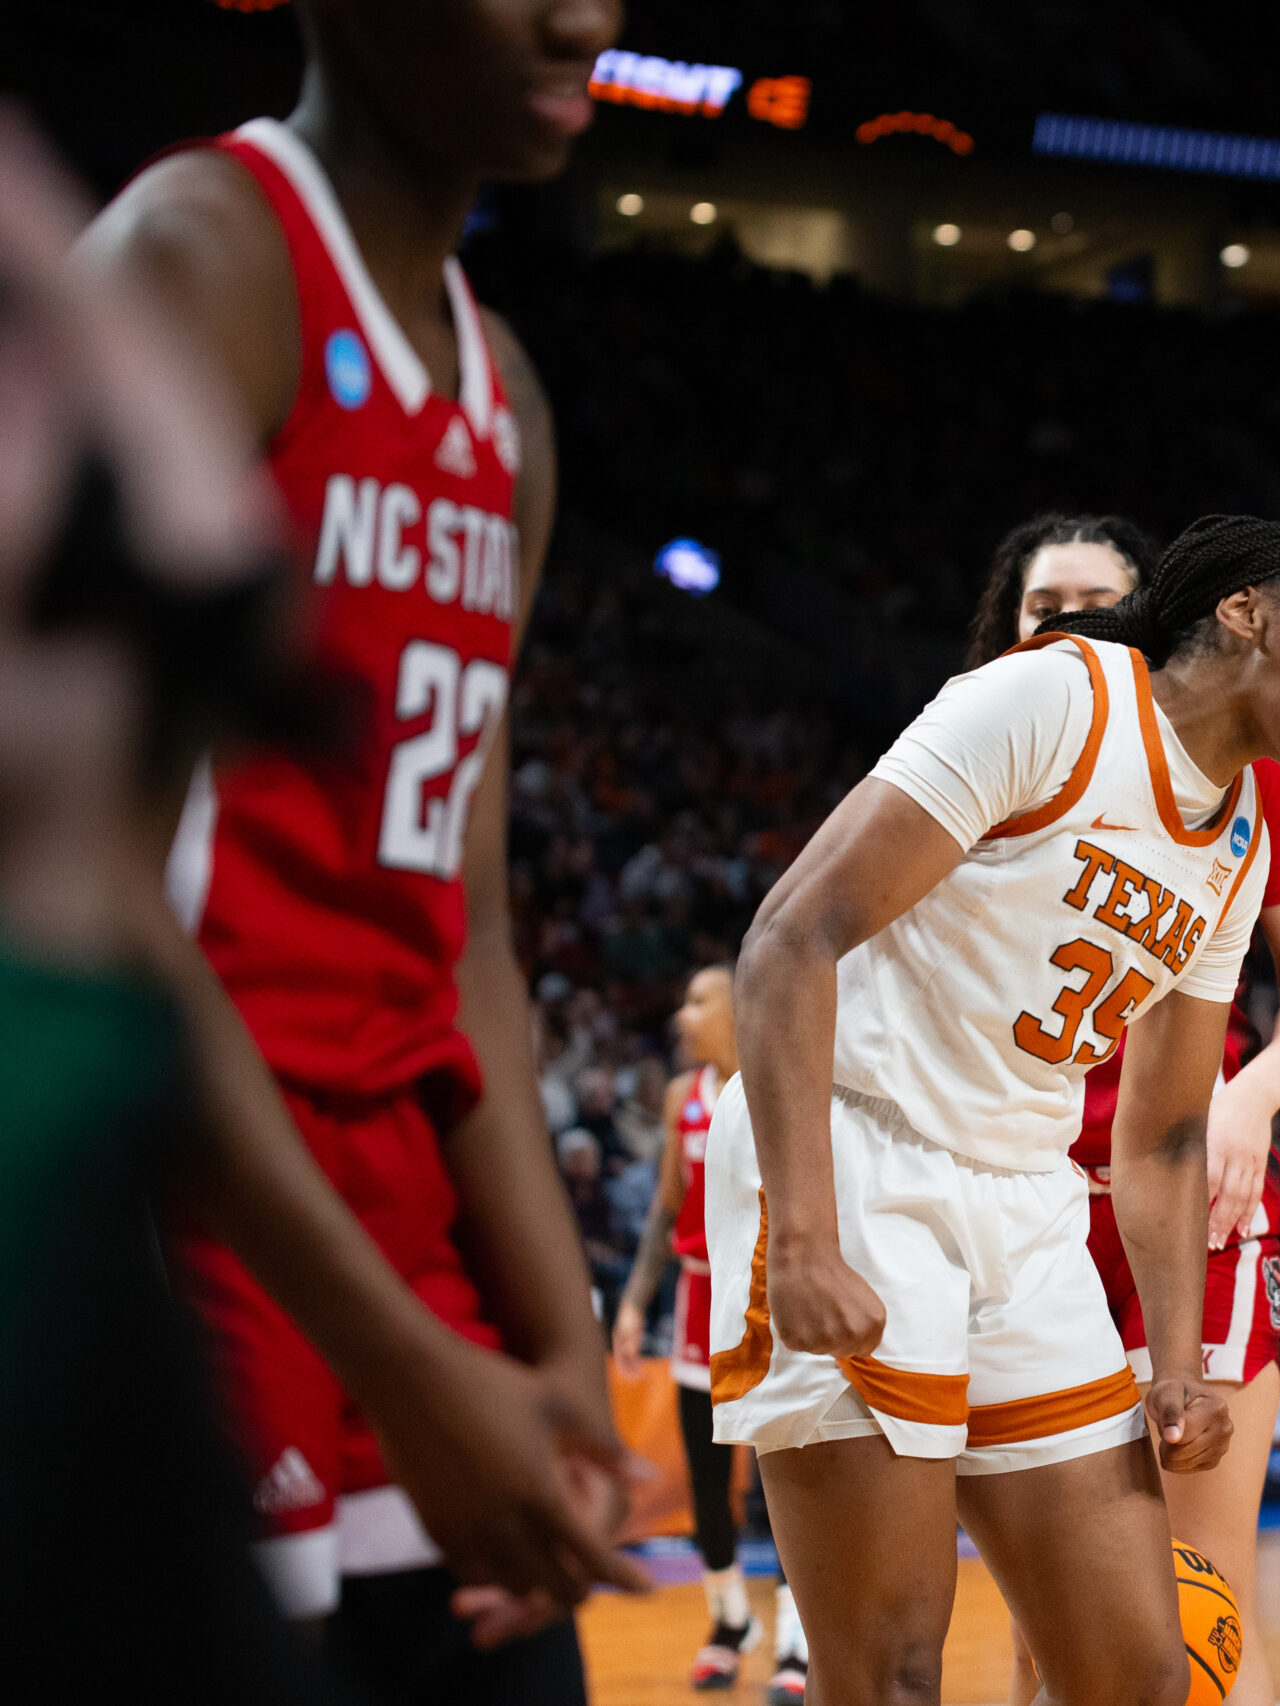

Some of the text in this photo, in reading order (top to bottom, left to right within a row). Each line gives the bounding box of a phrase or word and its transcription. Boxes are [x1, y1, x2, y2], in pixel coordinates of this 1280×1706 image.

[313, 473, 517, 622] NC STA
[1063, 840, 1206, 975] TEXAS
[1013, 938, 1155, 1065] 35
